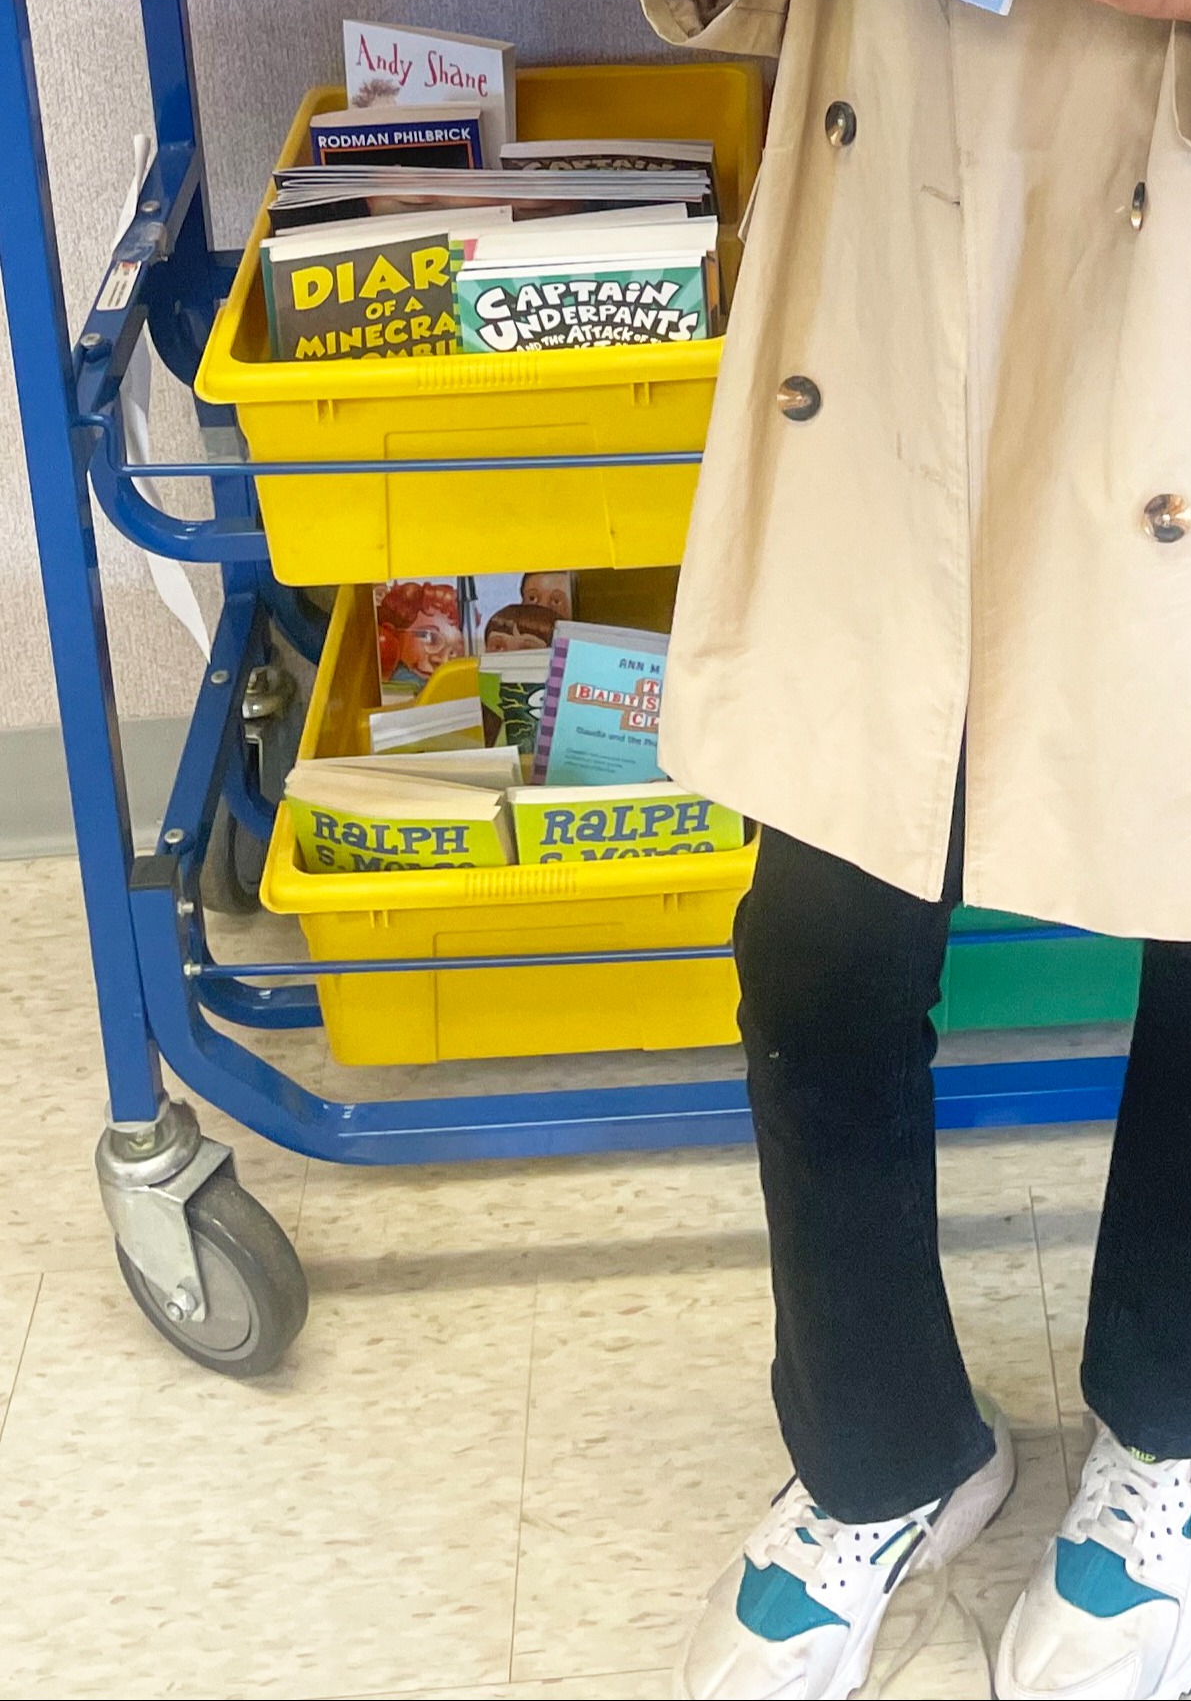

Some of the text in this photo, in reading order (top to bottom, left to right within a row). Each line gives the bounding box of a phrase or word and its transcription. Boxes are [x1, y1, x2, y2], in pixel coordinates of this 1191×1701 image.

[356, 33, 488, 98] Andy Shane
[318, 127, 471, 148] RODMAN PHILBRICK
[291, 246, 450, 311] DIAR
[365, 296, 424, 320] OF A
[295, 311, 456, 359] MINECRA
[478, 305, 699, 351] UNDERPANTS
[566, 325, 633, 344] ATTACK
[619, 658, 645, 672] ANN
